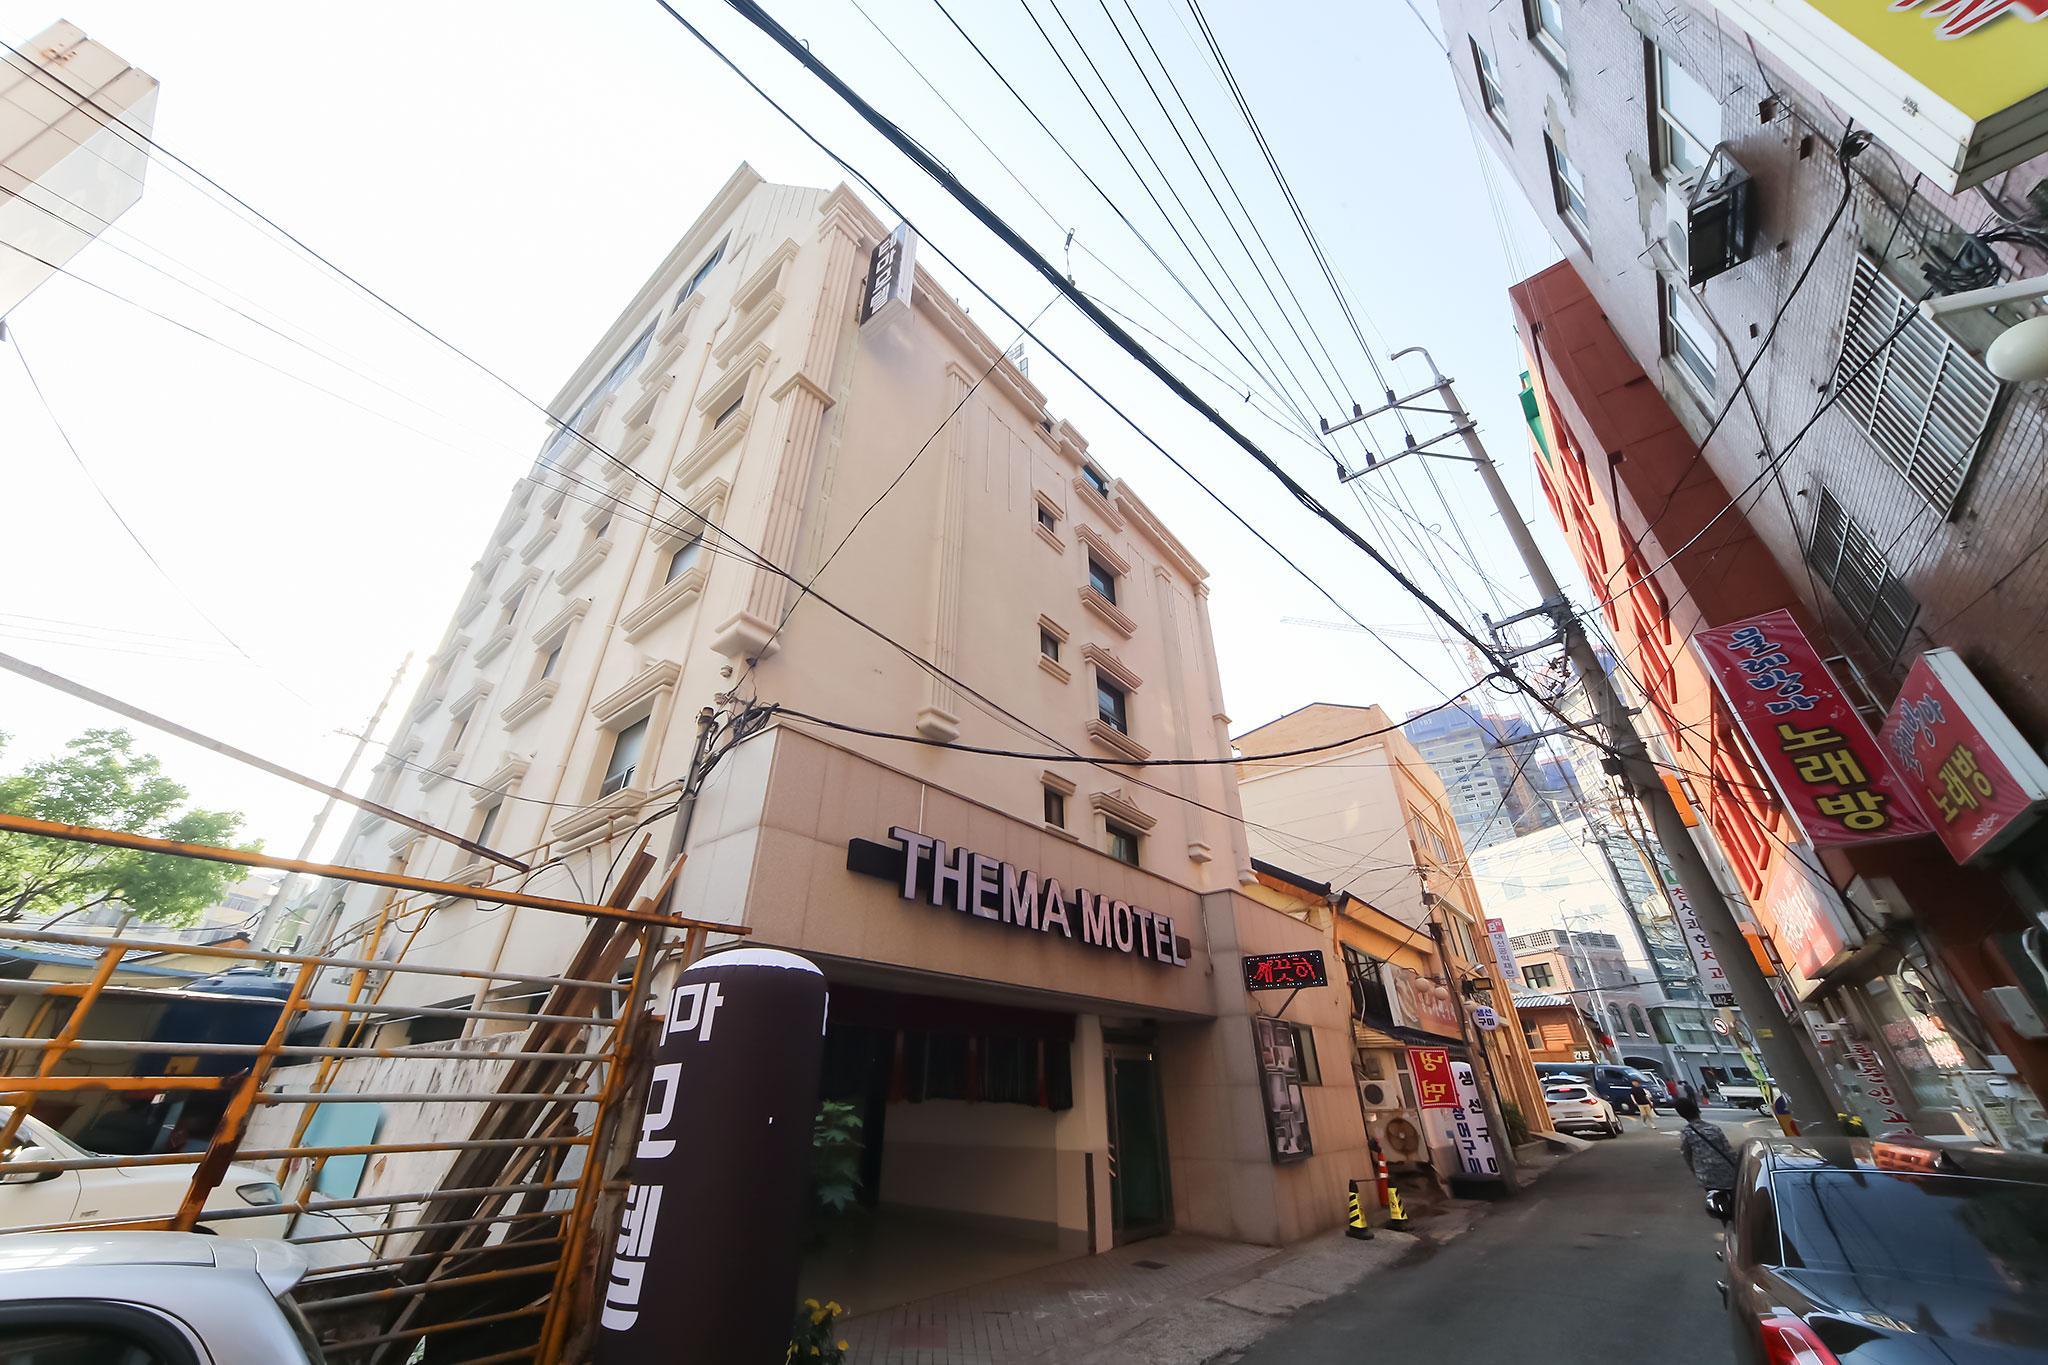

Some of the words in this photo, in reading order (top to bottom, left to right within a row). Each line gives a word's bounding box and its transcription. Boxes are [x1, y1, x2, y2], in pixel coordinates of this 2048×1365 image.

[1778, 723, 1885, 830] 노래방
[1928, 744, 1992, 823] 노래방
[889, 826, 1072, 938] THEMA
[1076, 888, 1187, 968] MOTEL
